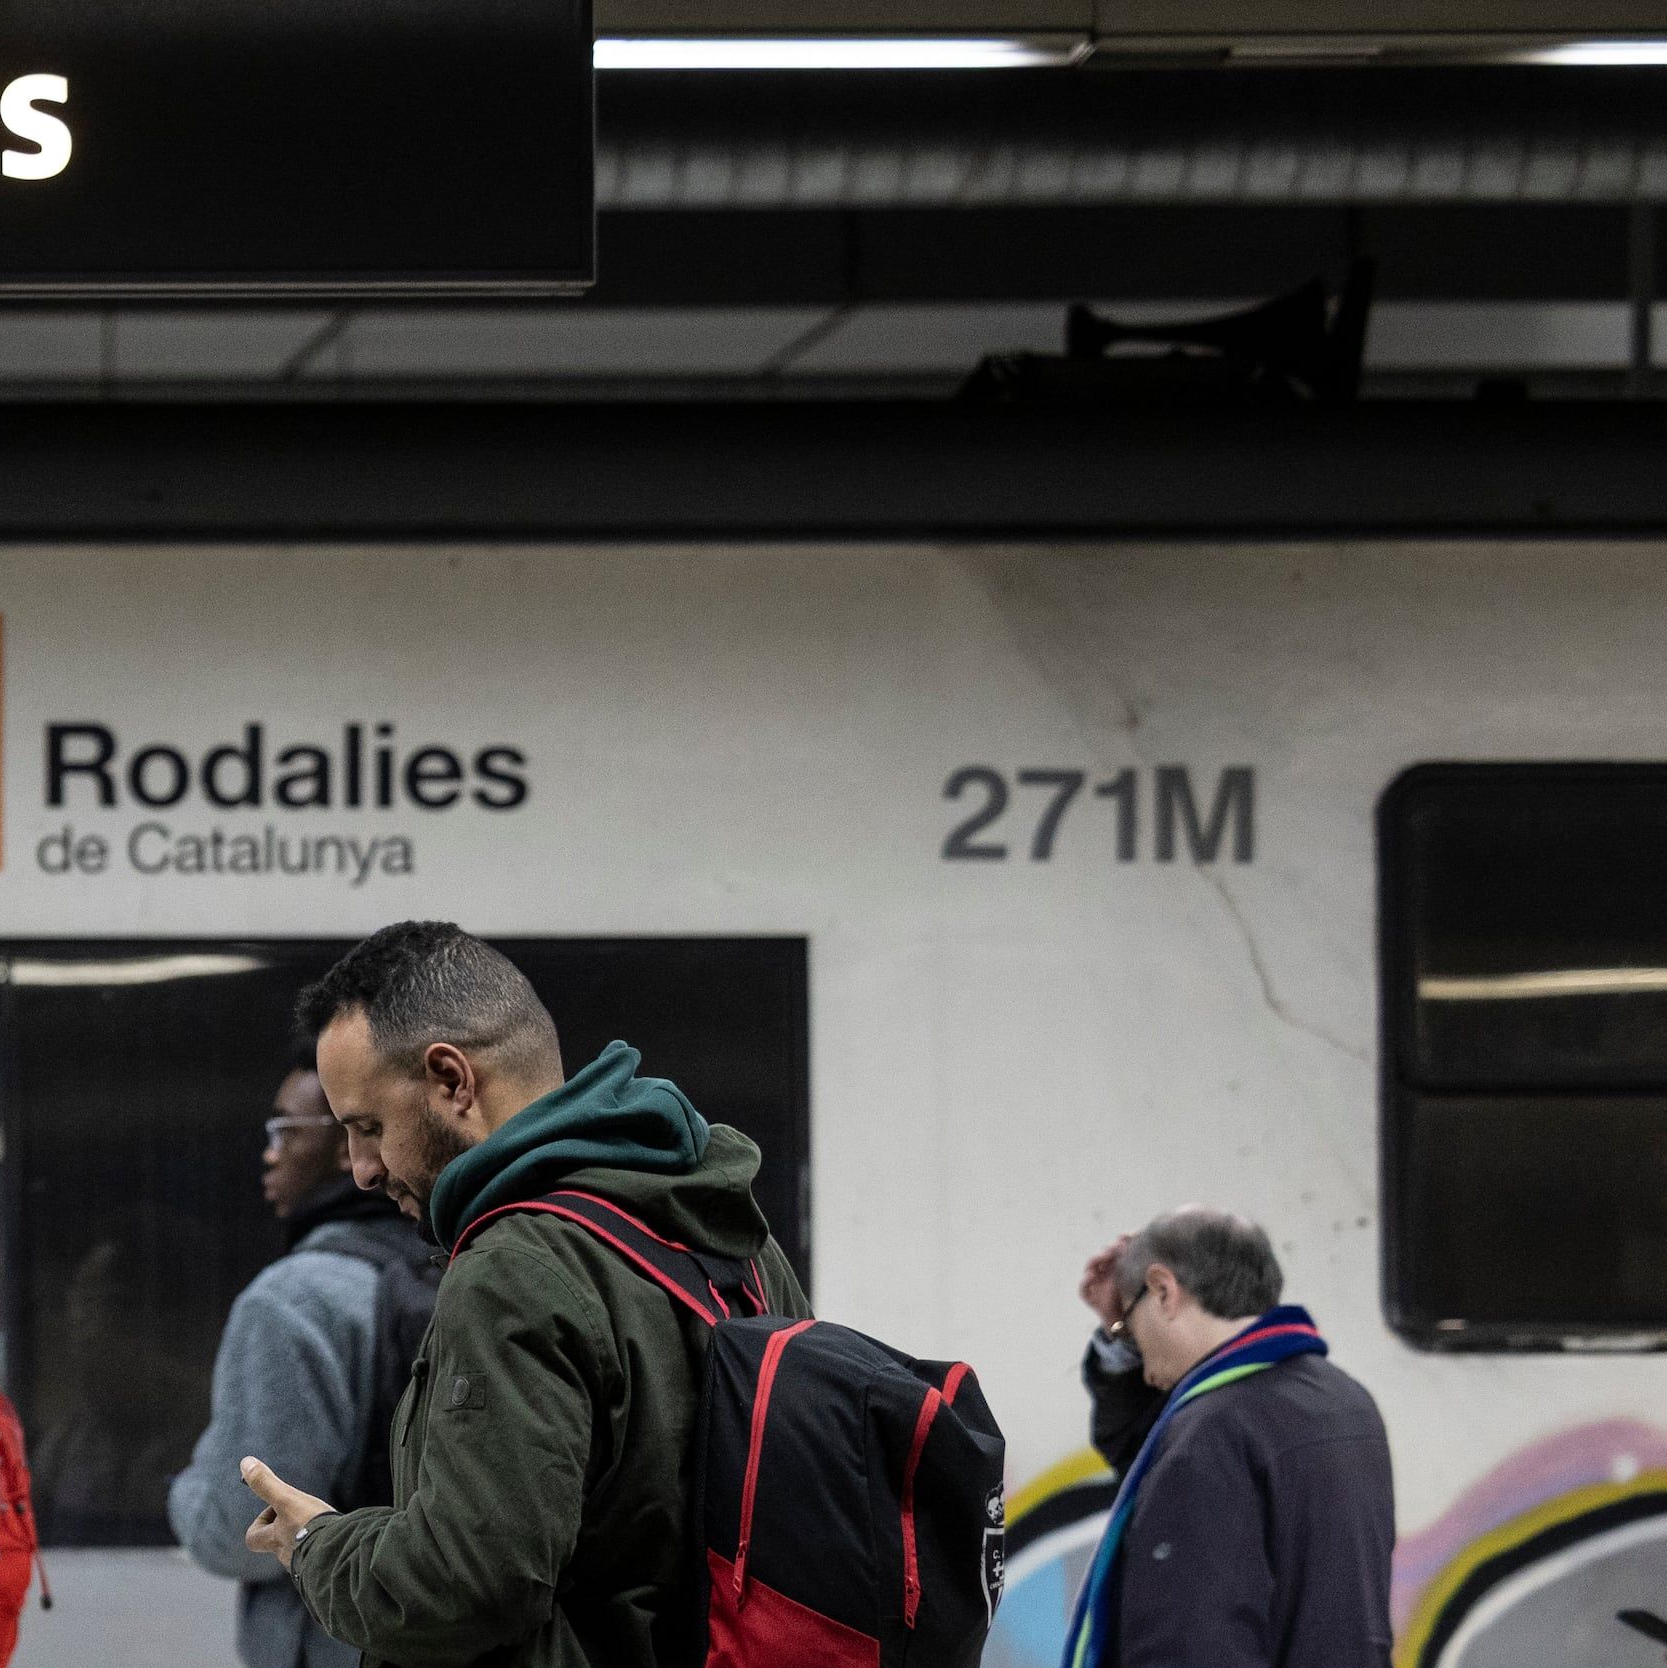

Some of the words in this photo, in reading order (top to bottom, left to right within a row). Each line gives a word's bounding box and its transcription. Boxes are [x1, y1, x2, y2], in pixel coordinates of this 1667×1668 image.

[44, 722, 529, 810] Rodalies
[36, 822, 109, 874] de
[128, 821, 417, 885] Catalunya
[942, 765, 1257, 864] 271M
